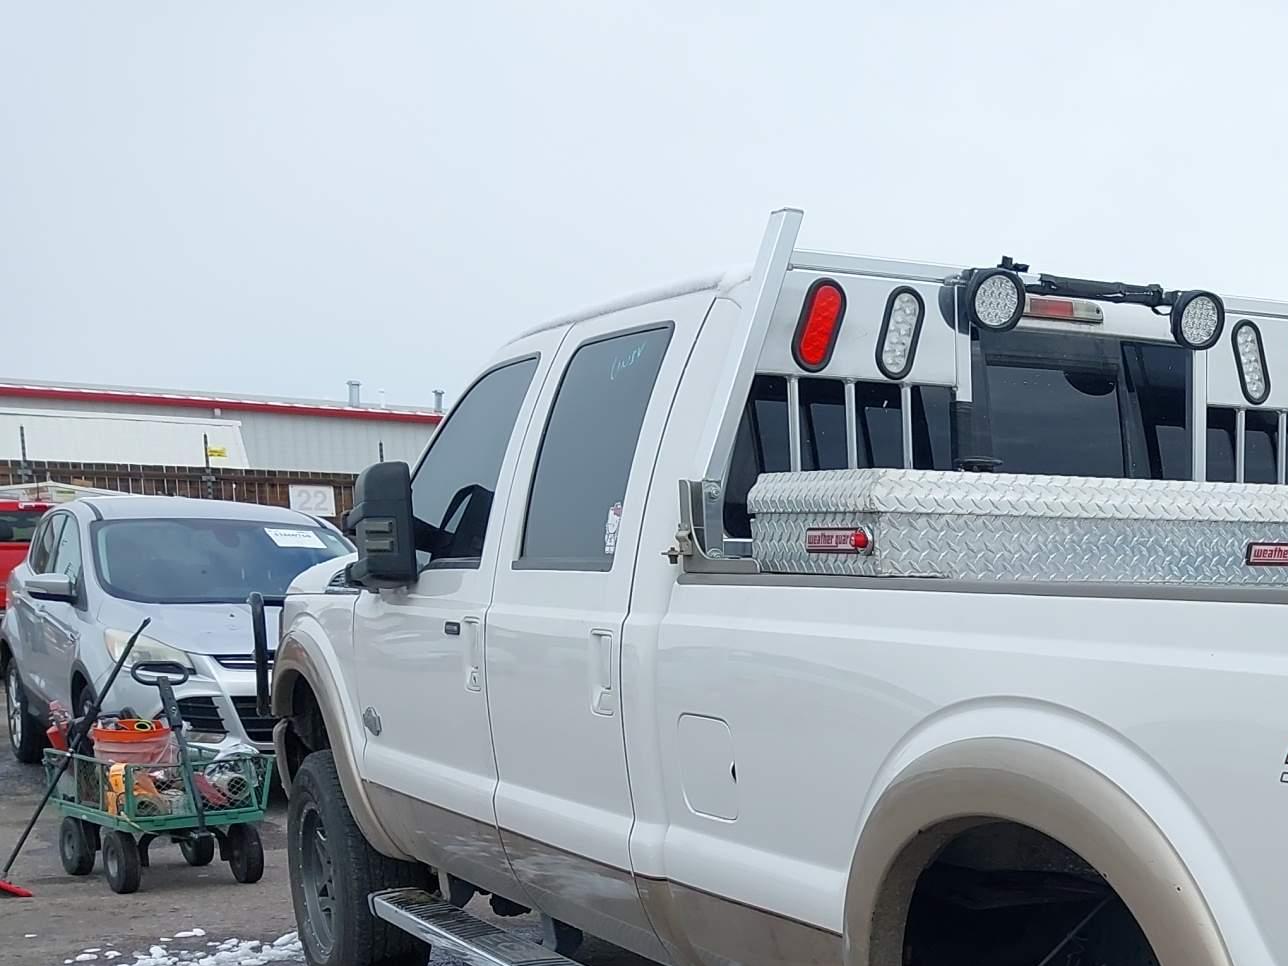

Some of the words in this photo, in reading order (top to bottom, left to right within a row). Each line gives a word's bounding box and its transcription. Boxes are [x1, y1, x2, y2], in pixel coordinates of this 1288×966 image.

[297, 489, 328, 511] 22
[808, 533, 834, 544] weather
[835, 535, 852, 547] guar
